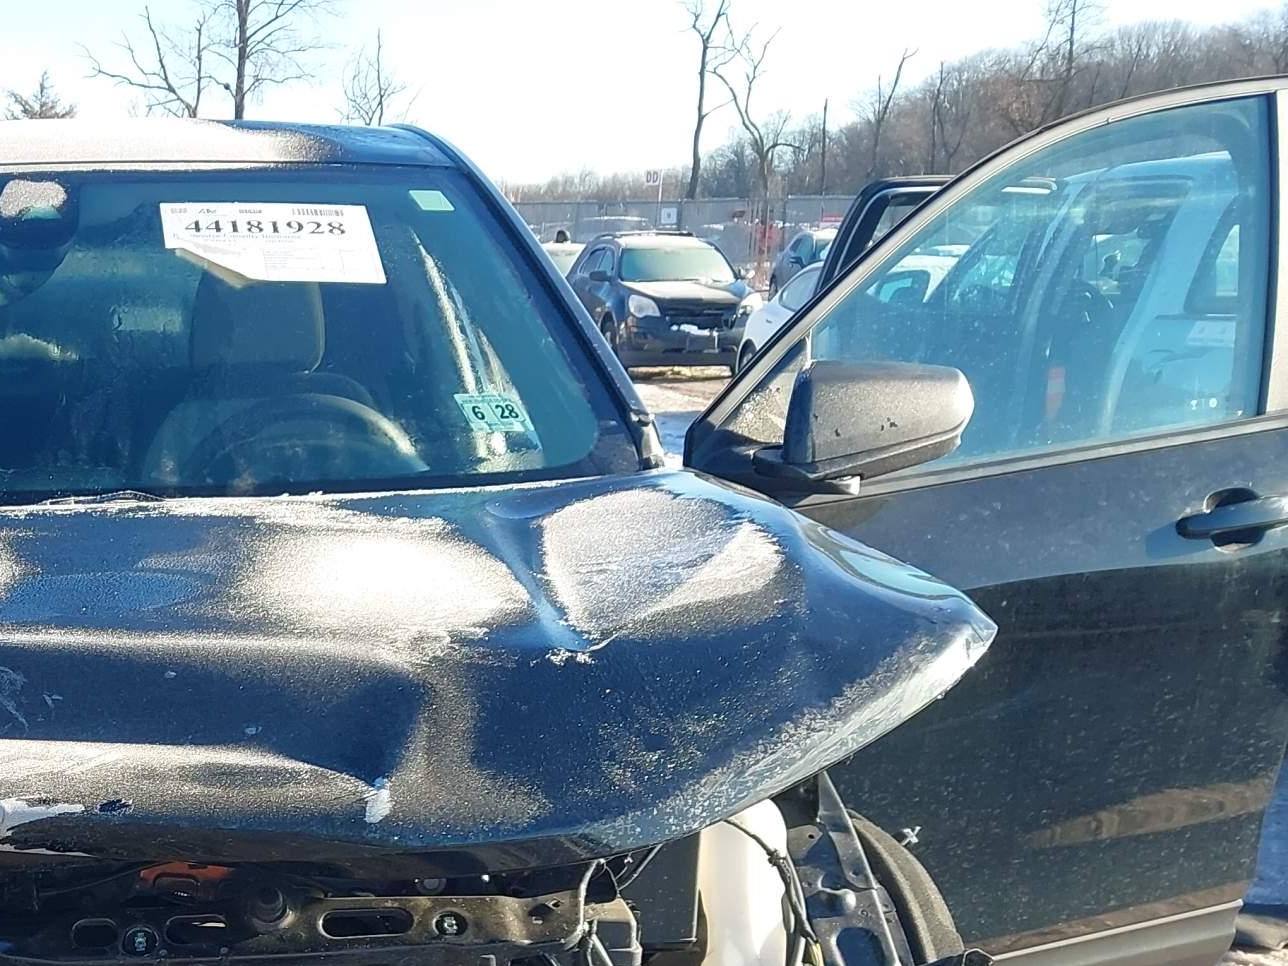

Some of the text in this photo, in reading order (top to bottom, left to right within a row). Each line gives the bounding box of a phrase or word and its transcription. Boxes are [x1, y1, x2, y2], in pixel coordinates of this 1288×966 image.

[184, 219, 347, 236] 44181928
[471, 403, 520, 421] 6 28
